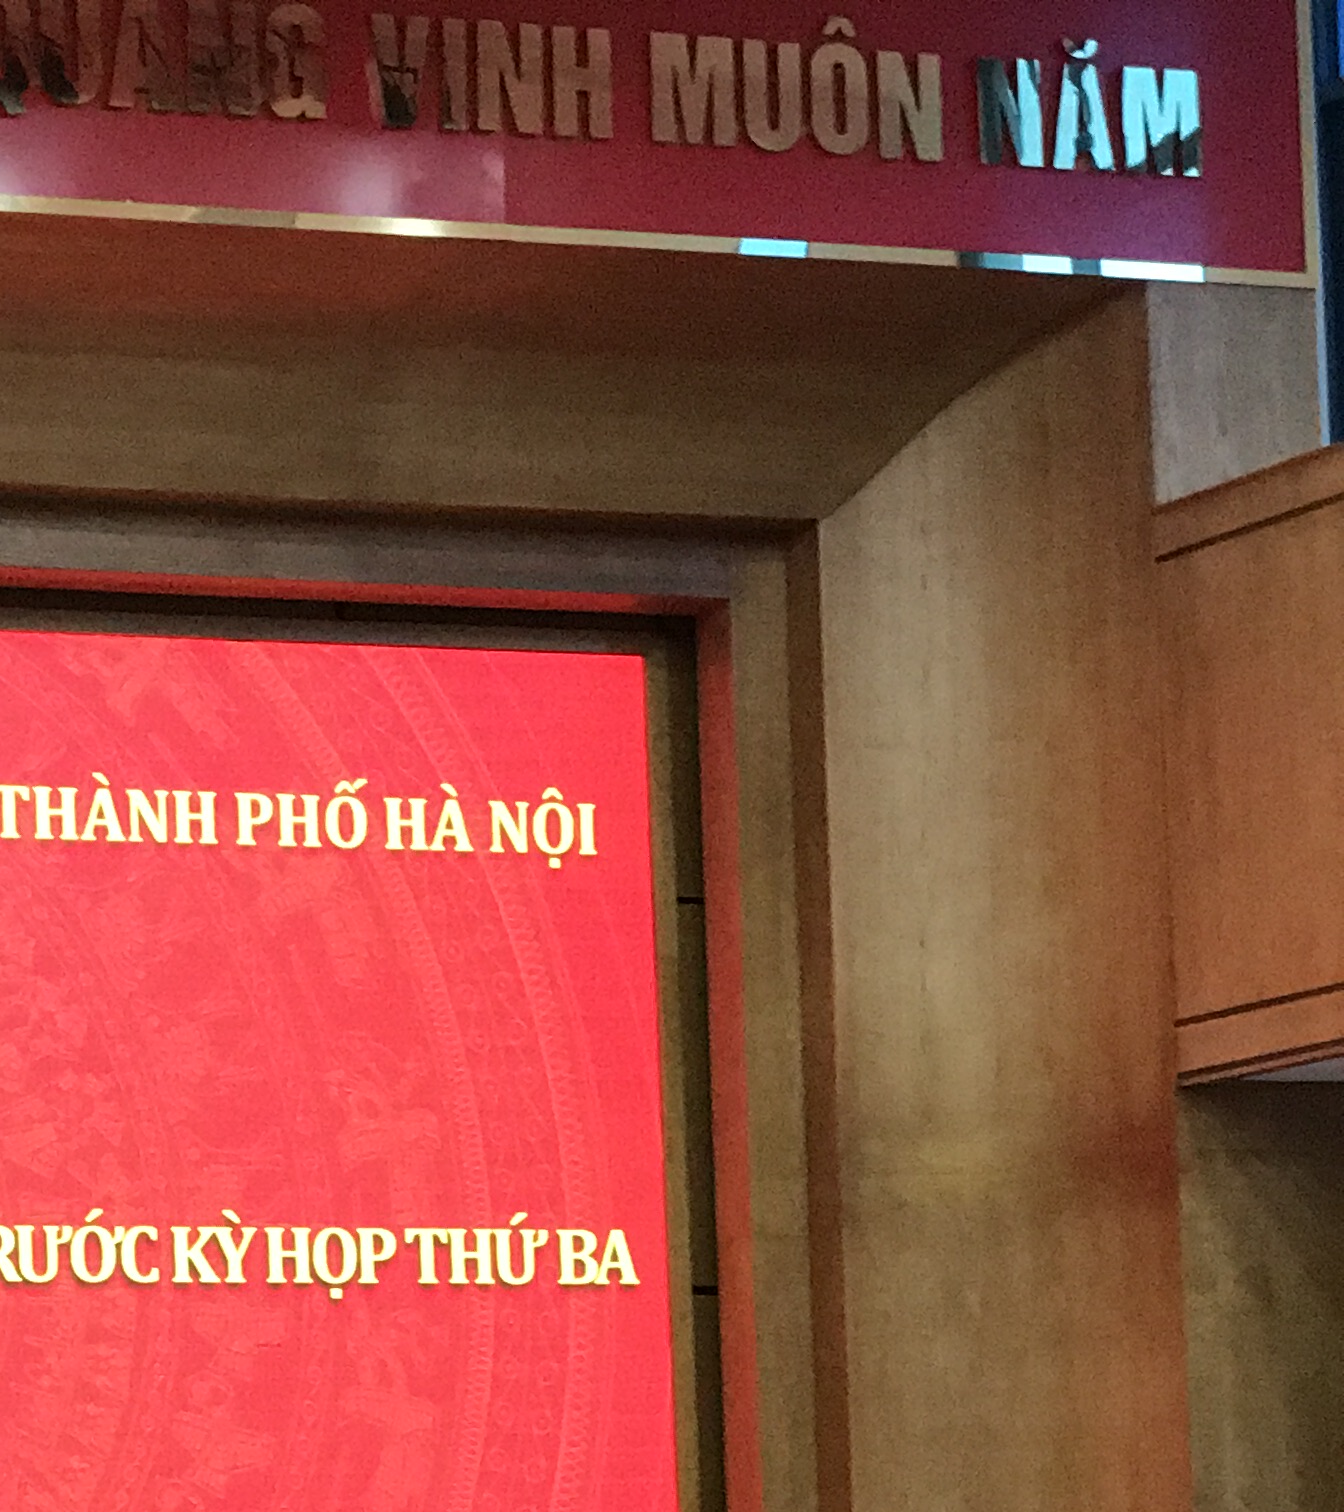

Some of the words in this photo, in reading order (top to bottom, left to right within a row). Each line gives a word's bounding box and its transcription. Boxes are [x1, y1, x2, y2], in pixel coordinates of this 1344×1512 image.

[368, 13, 614, 138] VINH
[650, 17, 946, 162] MUÔN
[977, 37, 1204, 178] NĂM
[234, 778, 368, 848] PHỐ
[384, 783, 474, 851] HÀ
[488, 787, 597, 868] NỘI
[170, 1209, 257, 1283] KỲ
[264, 1227, 396, 1299] HỌP
[405, 1212, 549, 1285] THỨ
[556, 1229, 640, 1284] BA
